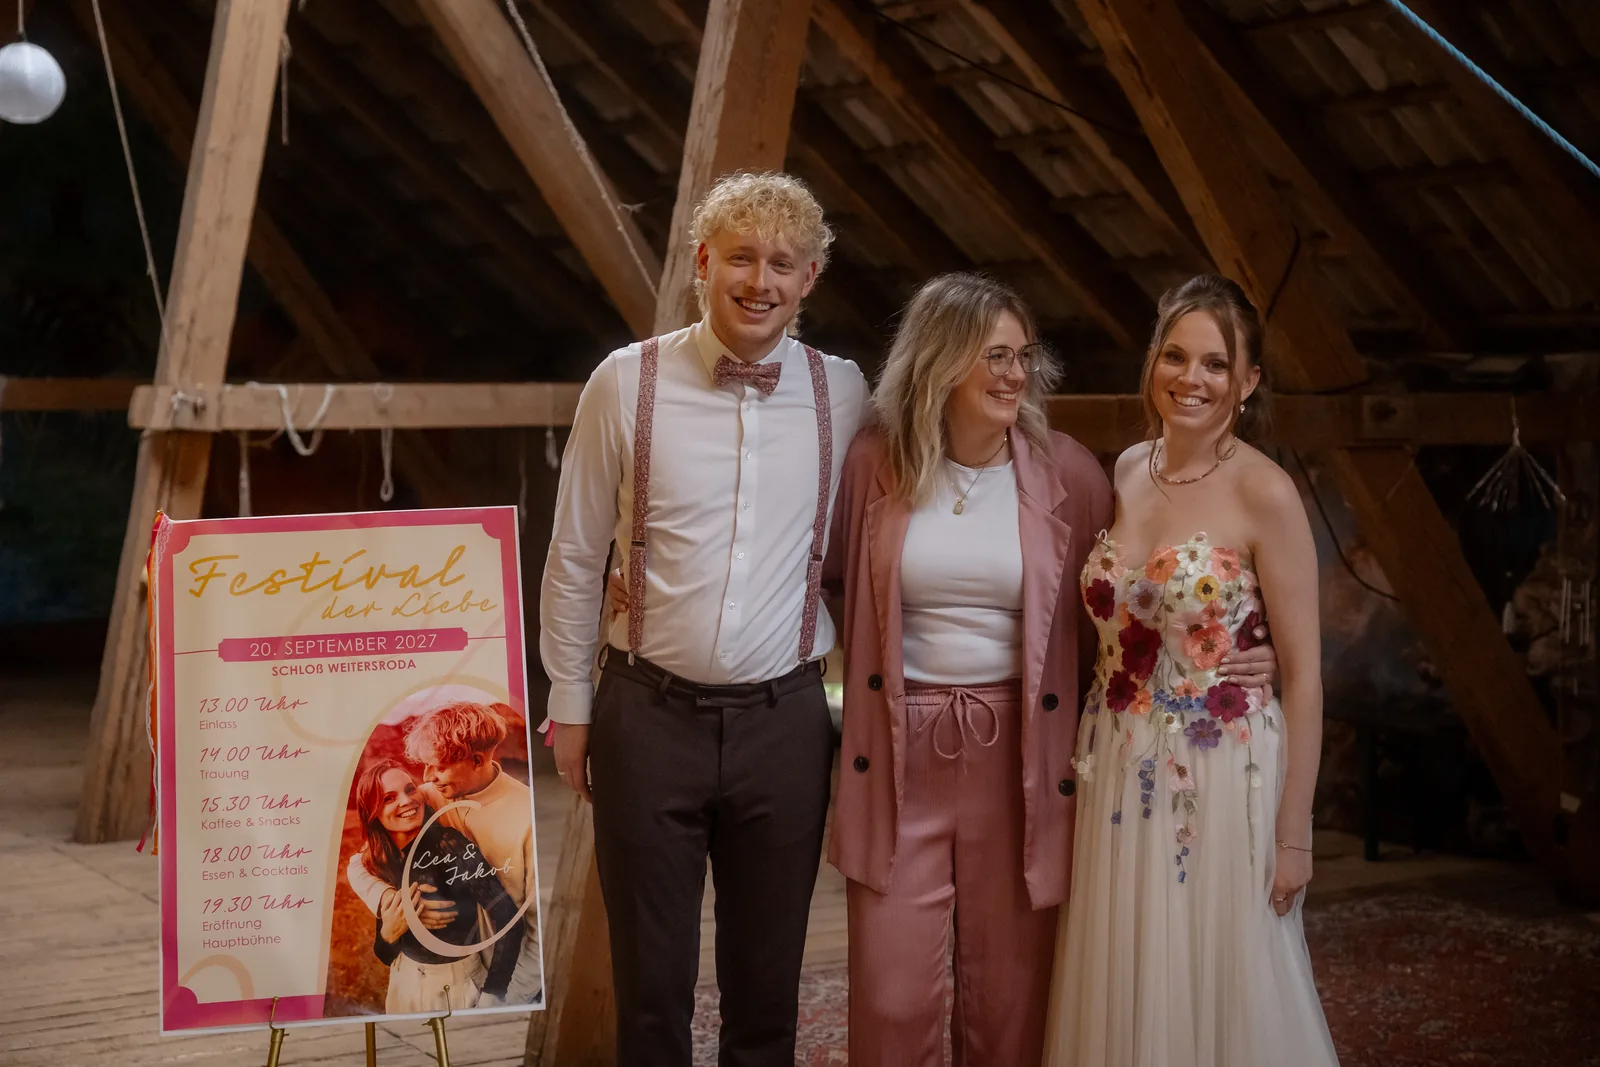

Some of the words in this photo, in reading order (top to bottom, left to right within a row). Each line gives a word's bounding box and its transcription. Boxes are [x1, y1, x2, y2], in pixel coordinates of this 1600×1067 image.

[189, 545, 466, 598] Festival
[321, 596, 382, 619] der
[392, 590, 498, 617] Liebe
[250, 642, 277, 657] 20.
[284, 636, 387, 655] SEPTEMBER
[395, 634, 437, 649] 2027
[328, 659, 416, 674] WEITERSRODA
[199, 697, 248, 714] 13.00
[254, 696, 308, 712] Uhr
[199, 719, 237, 730] Einlass
[200, 746, 250, 763] 14.00
[256, 745, 310, 761] Uhr
[200, 768, 249, 780] Trauung
[201, 795, 250, 813] 15.30
[256, 794, 311, 809] Uhr
[201, 817, 242, 830] Kaffee
[246, 817, 254, 827] &
[258, 815, 300, 826] Snacks
[202, 845, 252, 863] 18.00
[257, 843, 312, 860] Uhr
[413, 850, 456, 869] Lea
[463, 844, 476, 859] &
[202, 869, 235, 880] Essen
[239, 867, 248, 878] &
[252, 864, 308, 877] Cocktails
[445, 858, 514, 885] Jakob
[202, 896, 252, 914] 19.30
[258, 894, 313, 910] Uhr
[202, 918, 262, 933] Eröffnung
[203, 934, 281, 949] Hauptbühne
